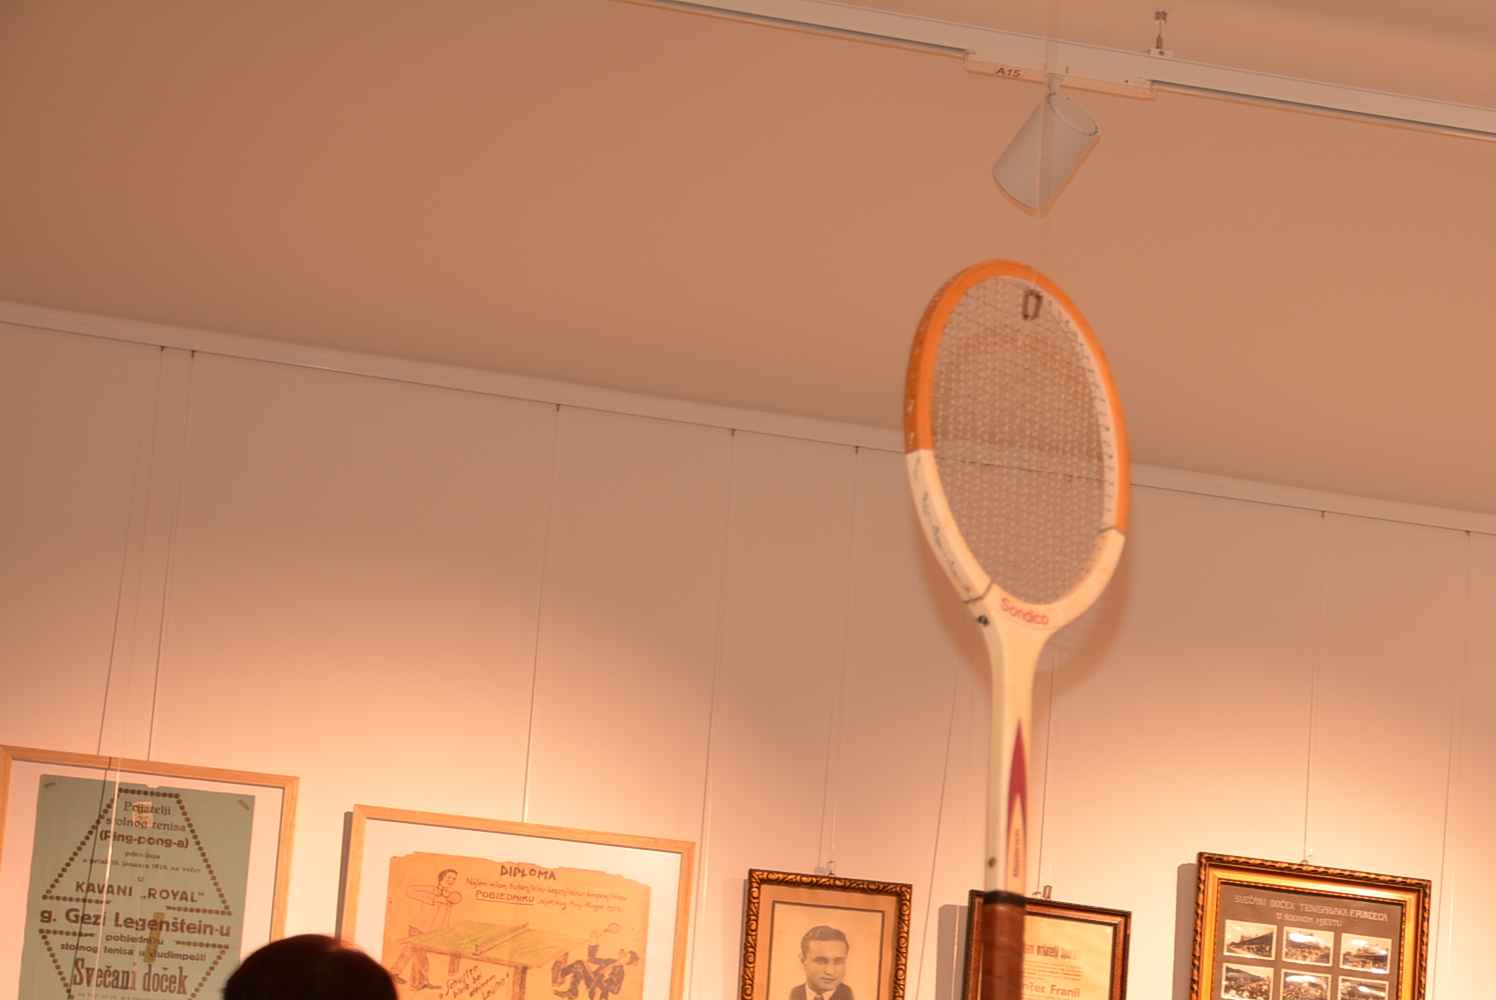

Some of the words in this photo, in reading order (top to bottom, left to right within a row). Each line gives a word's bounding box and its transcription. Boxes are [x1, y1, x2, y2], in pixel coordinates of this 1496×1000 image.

[106, 816, 149, 830] solnog
[500, 864, 557, 881] DIPLOMA
[75, 881, 134, 897] KAVANI
[39, 910, 57, 924] g.
[150, 950, 207, 962] udimpešti
[73, 957, 138, 992] Svečani
[142, 963, 189, 995] doček
